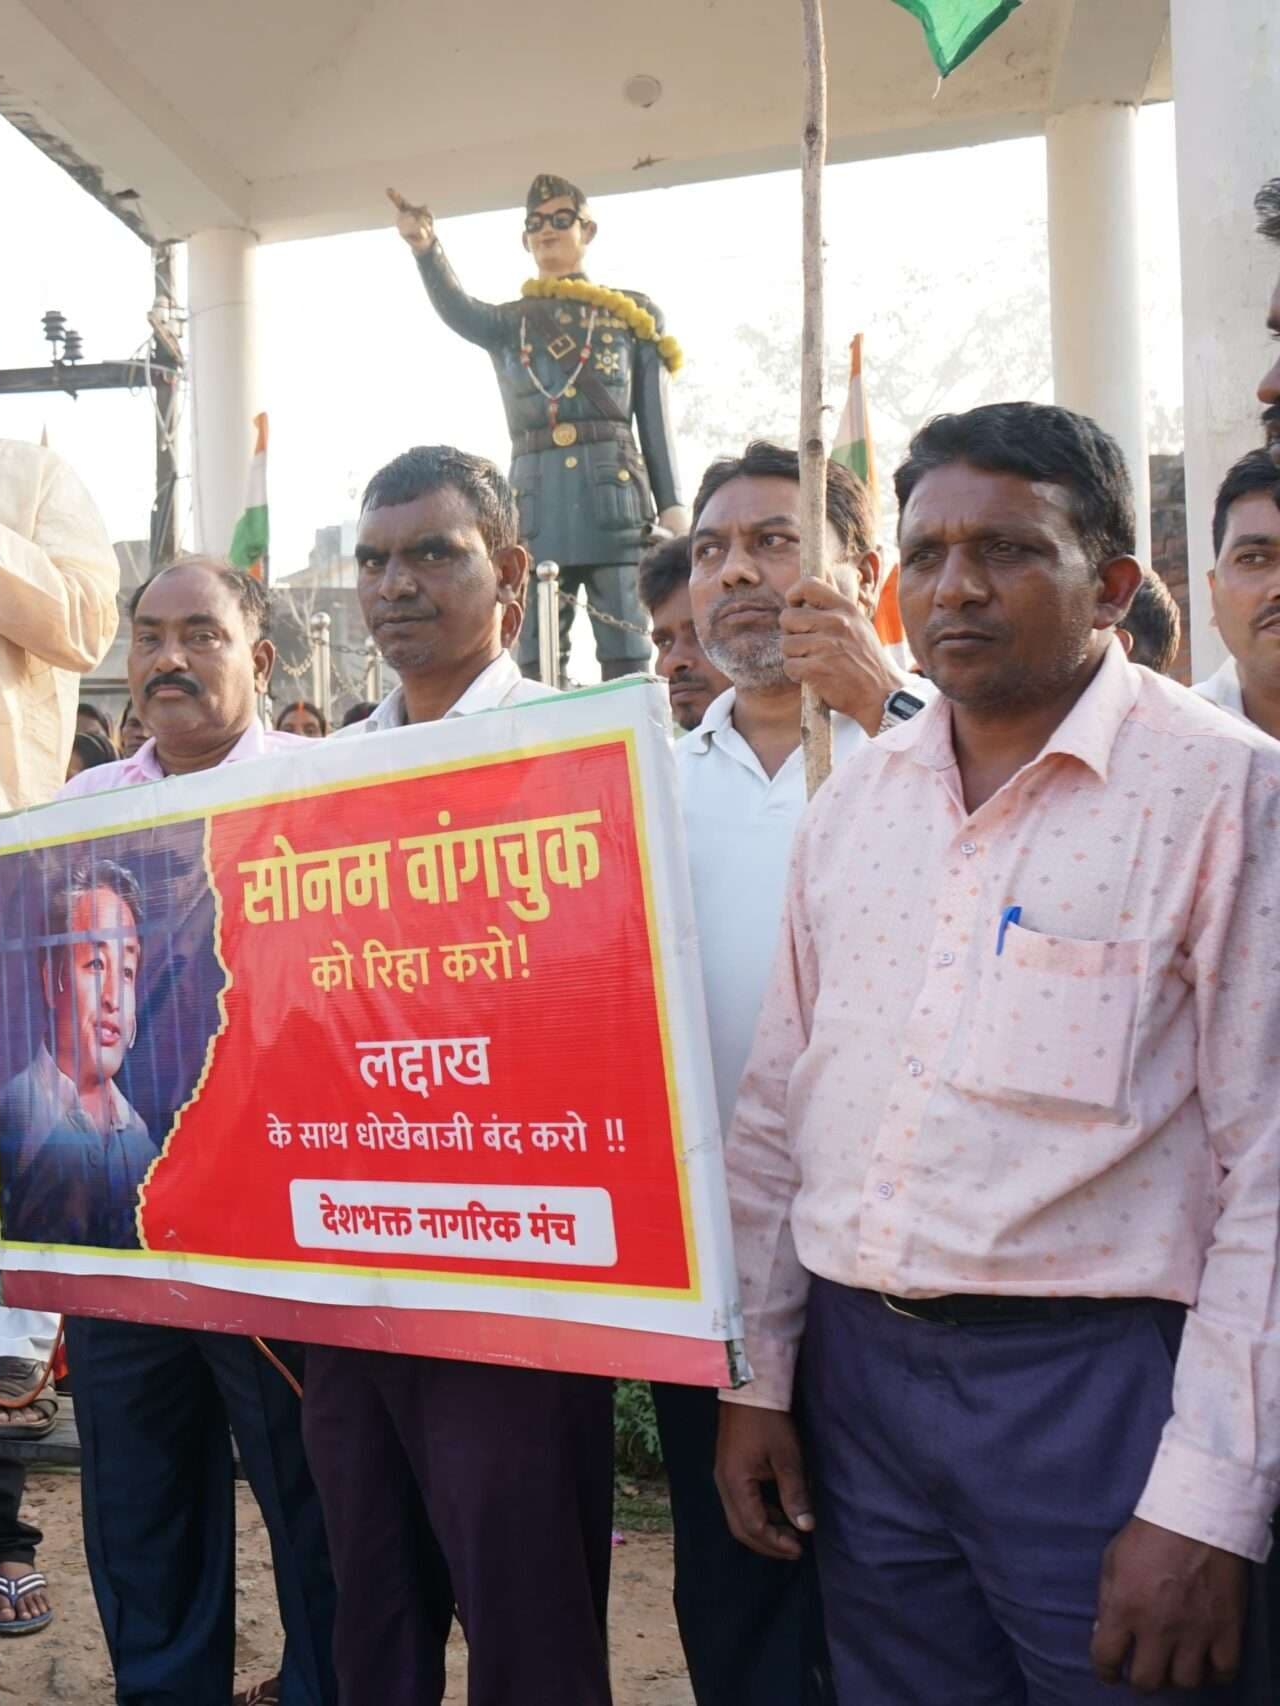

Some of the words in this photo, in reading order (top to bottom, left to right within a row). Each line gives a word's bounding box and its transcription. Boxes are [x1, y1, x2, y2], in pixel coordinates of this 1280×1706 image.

[238, 835, 391, 924] सोनम
[399, 810, 603, 922] वांगचुक
[310, 940, 354, 993] को
[362, 939, 430, 995] रिहा
[439, 926, 531, 982] करो!
[356, 1035, 492, 1098] लद्दाख
[267, 1113, 293, 1149] के
[298, 1121, 349, 1150] साथ
[357, 1112, 474, 1151] धोखेबाजी
[481, 1113, 523, 1153] बंद
[529, 1111, 588, 1153] करो
[319, 1193, 412, 1236] देशभक्त
[418, 1201, 521, 1243] नागरिक
[528, 1203, 576, 1246] मंच
